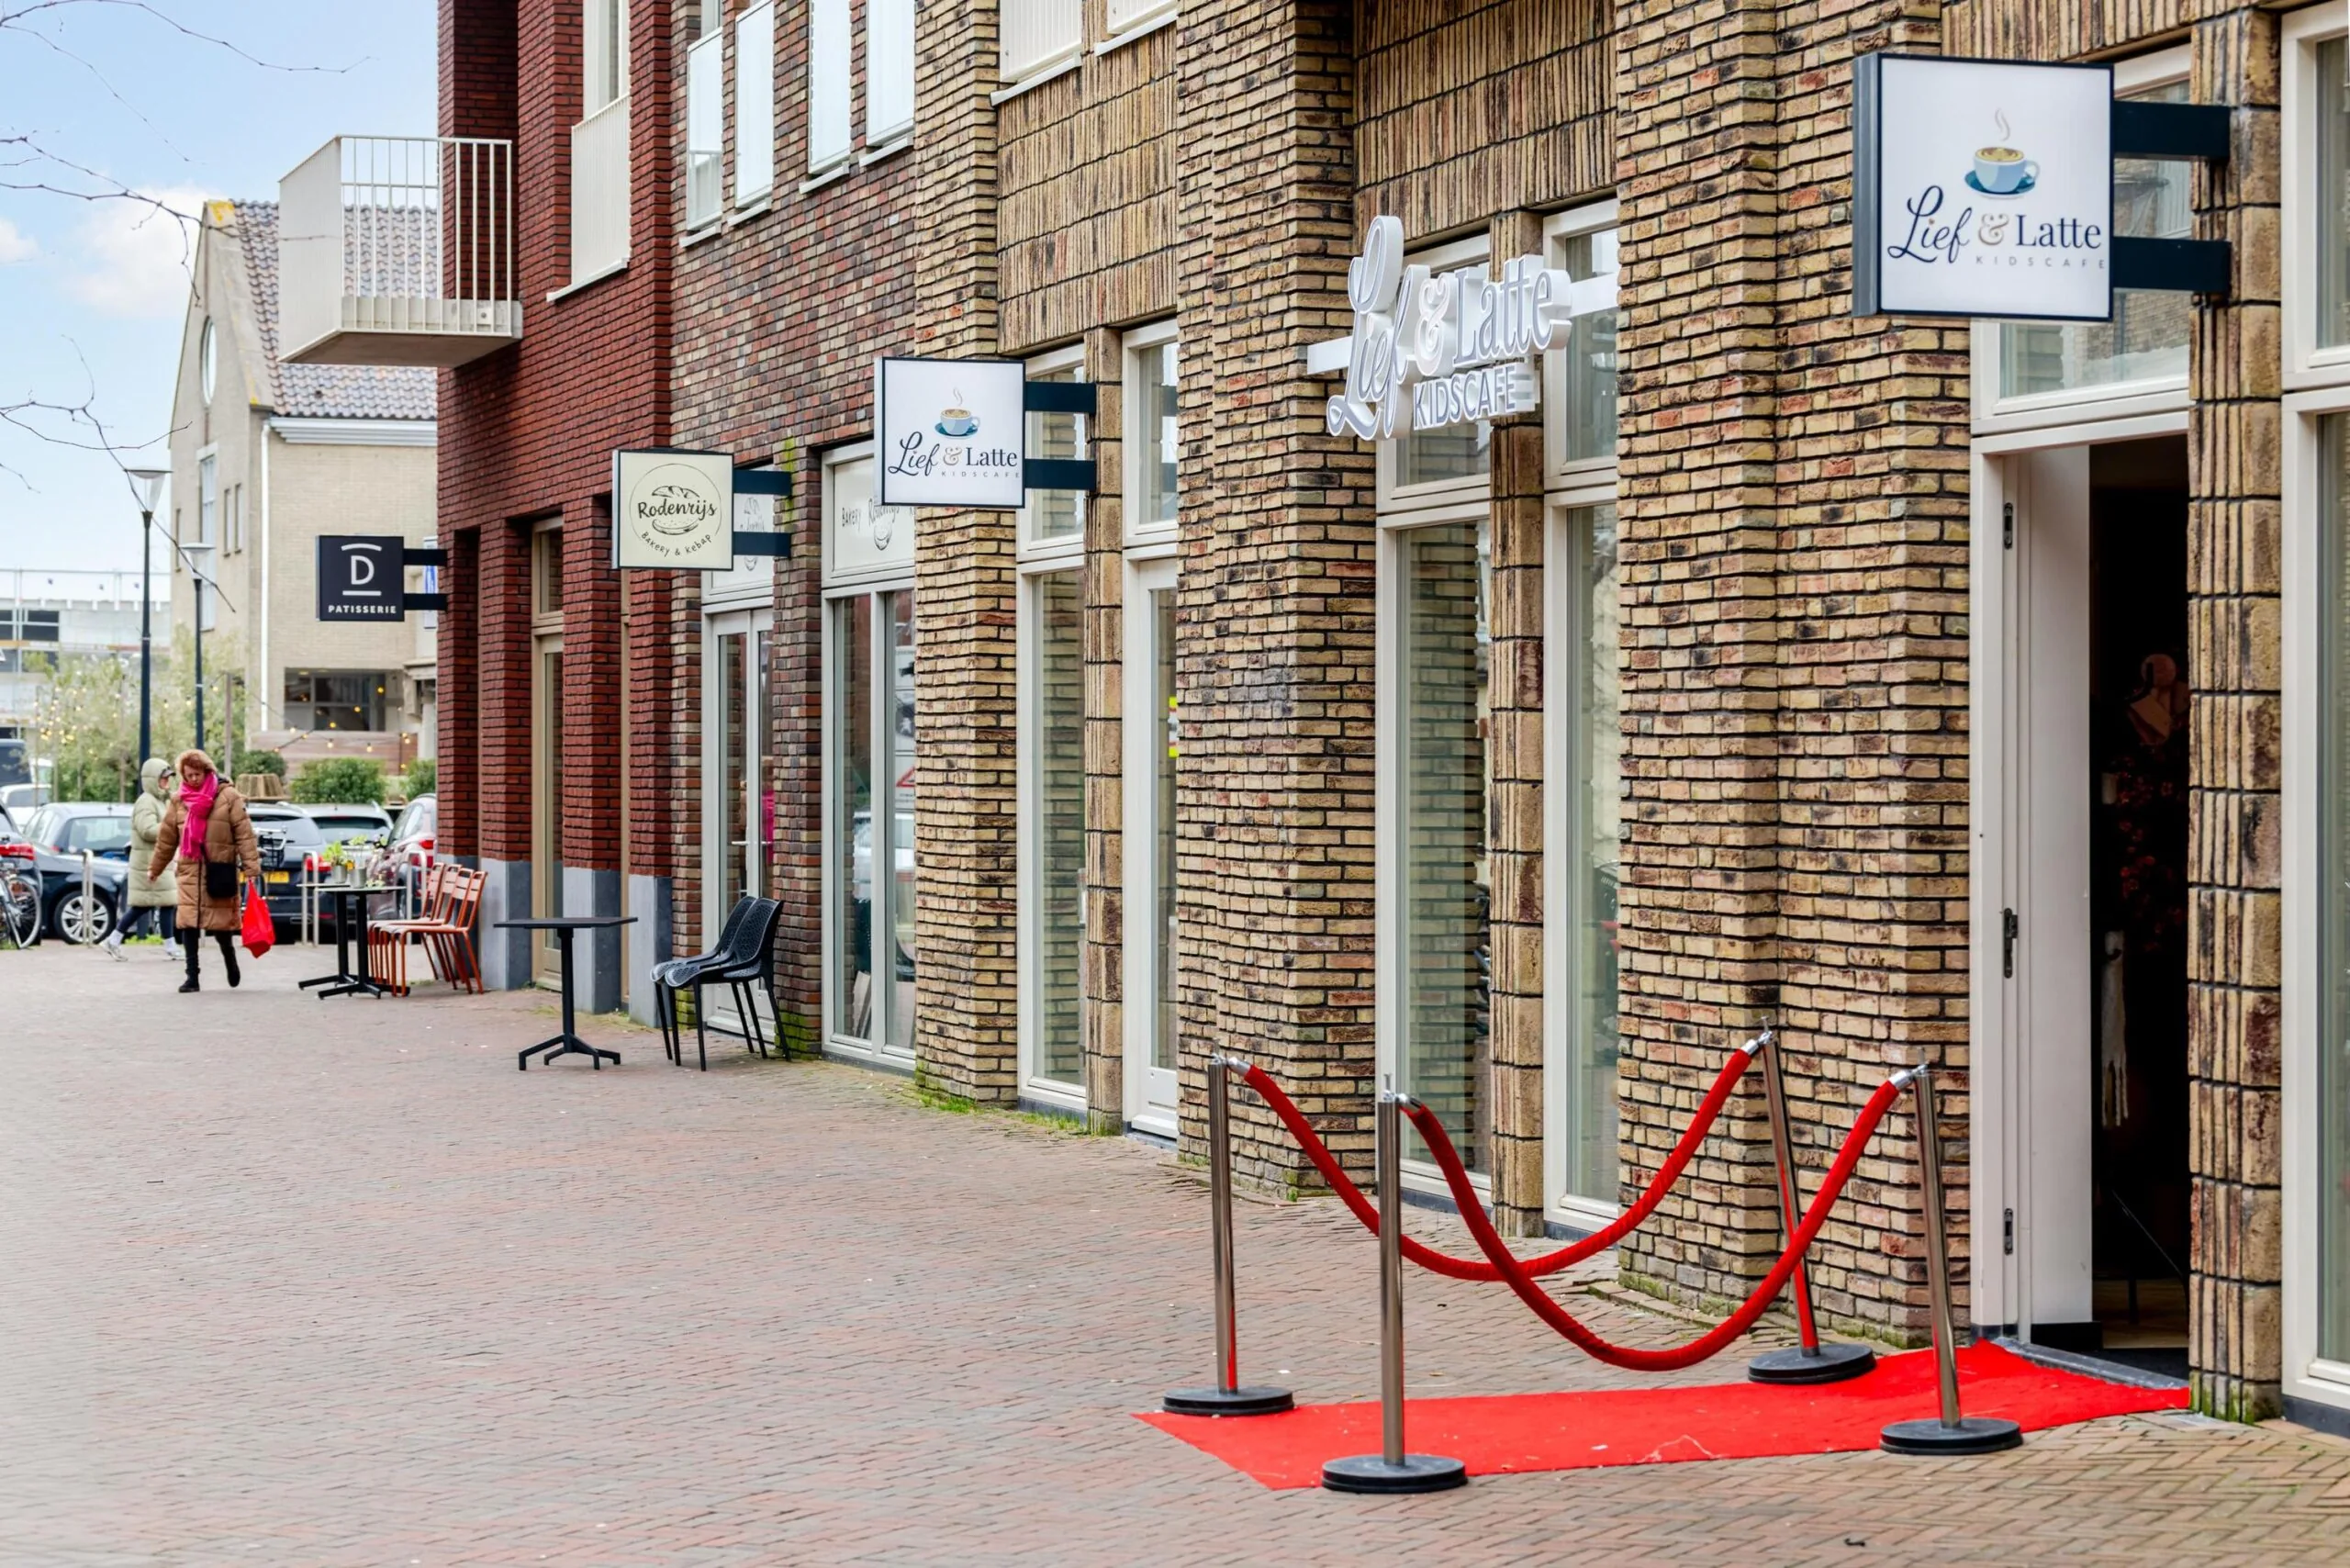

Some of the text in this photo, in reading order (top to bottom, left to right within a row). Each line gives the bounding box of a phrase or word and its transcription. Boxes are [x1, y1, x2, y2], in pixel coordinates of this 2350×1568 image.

[1887, 185, 2102, 263] Lief & Latte
[1975, 255, 2105, 269] KIDSCAFE
[1326, 215, 1571, 441] Lief & Latte
[1413, 364, 1531, 431] KIDSCAFE
[887, 431, 1018, 476] Lief & Latte
[941, 470, 1020, 478] KIDSCAFE
[637, 498, 717, 521] Rodenrijs
[351, 554, 375, 585] D
[328, 605, 397, 614] PATISSERIE
